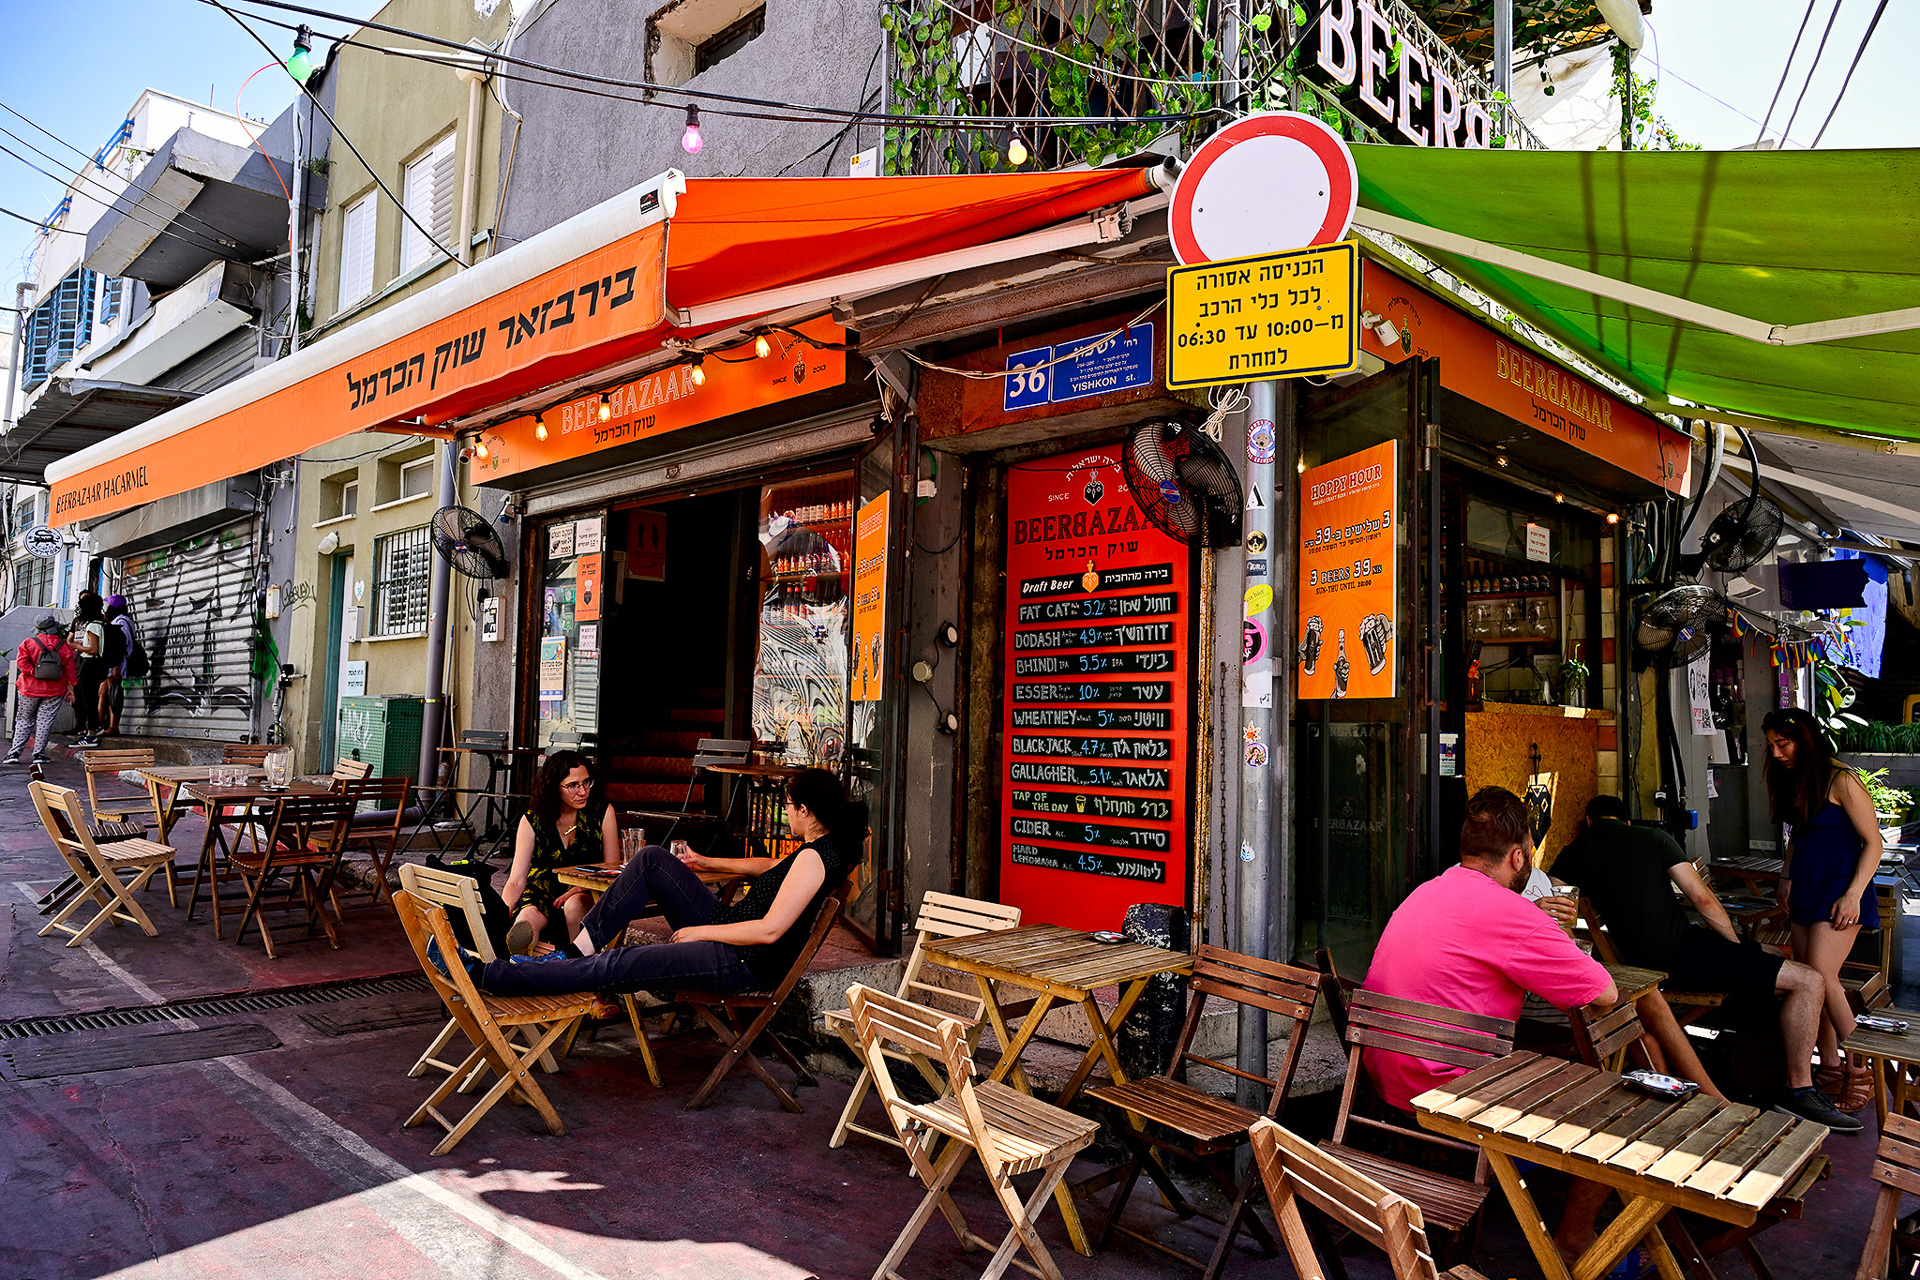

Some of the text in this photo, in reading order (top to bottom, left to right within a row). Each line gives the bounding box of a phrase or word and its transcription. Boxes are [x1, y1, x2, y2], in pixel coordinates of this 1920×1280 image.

[1196, 258, 1324, 291] הכניסה אסורה
[1199, 286, 1321, 318] לכל כלי הרכב
[1177, 328, 1226, 348] 06:30
[1234, 323, 1258, 341] עד
[430, 326, 487, 391] שוק
[1228, 347, 1288, 370] למחרת
[346, 352, 425, 411] הכרמל
[1009, 359, 1046, 398] 36
[1072, 373, 1136, 392] YISHKON st.
[1496, 339, 1613, 433] BEERBAZAAR
[561, 364, 696, 435] BEEBAZAAR
[1530, 397, 1586, 441] שוק הכרמל
[594, 414, 656, 444] שוק הכרמל
[1311, 464, 1383, 500] HOPPY HOUR
[56, 482, 102, 514] BEERBAZAAR
[1048, 492, 1070, 502] SINCE
[1344, 518, 1381, 538] שלישים
[1382, 509, 1391, 529] 3
[1045, 540, 1139, 561] שוק הכרמל
[1104, 568, 1169, 584] בירה מהחבית
[1310, 558, 1383, 587] 3 BEERS 39 NIS
[1022, 579, 1075, 594] Draft Beer
[1339, 581, 1356, 591] UNTIL
[1019, 602, 1071, 621] FAT CAT
[1083, 599, 1106, 616] 5.2%
[1119, 595, 1171, 616] חתול שמן
[1015, 631, 1061, 649] DODASH
[1079, 628, 1102, 645] 4.9%
[1016, 657, 1058, 674] BHINDI
[1059, 660, 1070, 670] IPA
[1079, 654, 1108, 672] 5.5%
[1111, 658, 1124, 668] IPA
[1135, 653, 1169, 670] בינדי
[1015, 684, 1059, 700] ESSER
[1079, 684, 1101, 701] 10%
[1132, 685, 1164, 700] עשר
[1013, 710, 1078, 726] WHEATNEY
[1098, 710, 1115, 727] 5%
[1080, 739, 1106, 755] 4.7%
[1133, 739, 1168, 759] בלאק
[1011, 763, 1077, 783] GALLAGHER
[1089, 768, 1112, 784] 5.1%
[1122, 768, 1165, 788] גלאגר
[1012, 790, 1048, 802] TAP OF
[1031, 801, 1069, 813] THE DAY
[1093, 796, 1169, 819] ברז מתחלף
[1013, 819, 1052, 836] CIDER
[1084, 825, 1101, 842] 5%
[1129, 831, 1166, 848] סיידר
[1012, 844, 1038, 855] HARD
[1012, 853, 1059, 868] LEMONANA
[1077, 854, 1103, 871] 4.5%
